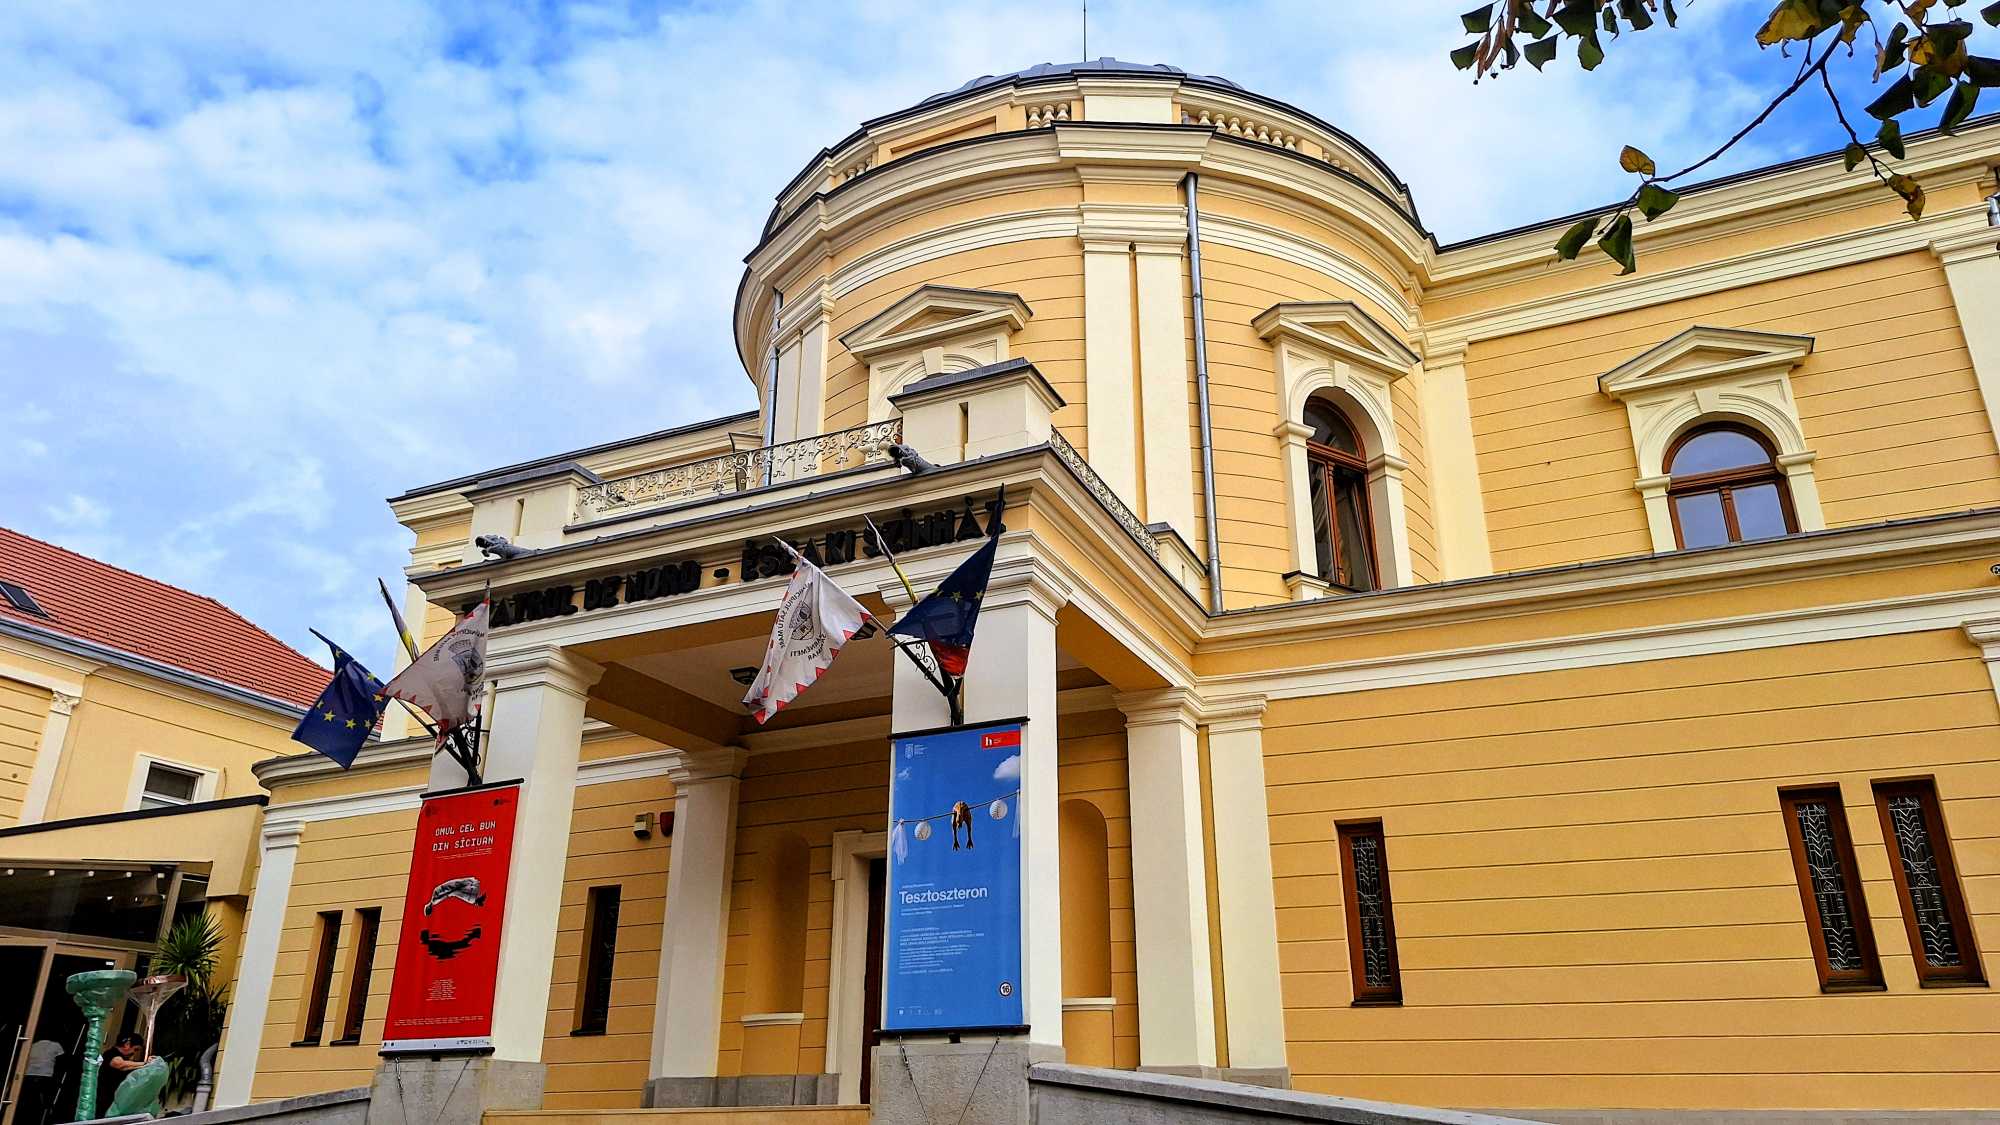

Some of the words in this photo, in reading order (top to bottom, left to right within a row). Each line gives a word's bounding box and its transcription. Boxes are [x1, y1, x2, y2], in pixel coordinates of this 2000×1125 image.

[462, 585, 578, 629] ATRUL
[584, 575, 624, 611] DE
[625, 560, 701, 603] NORD
[435, 826, 455, 837] OMUL
[459, 823, 475, 833] CEL
[479, 820, 496, 831] BUN
[432, 841, 449, 852] DIN
[898, 887, 988, 905] Tesztoszteron
